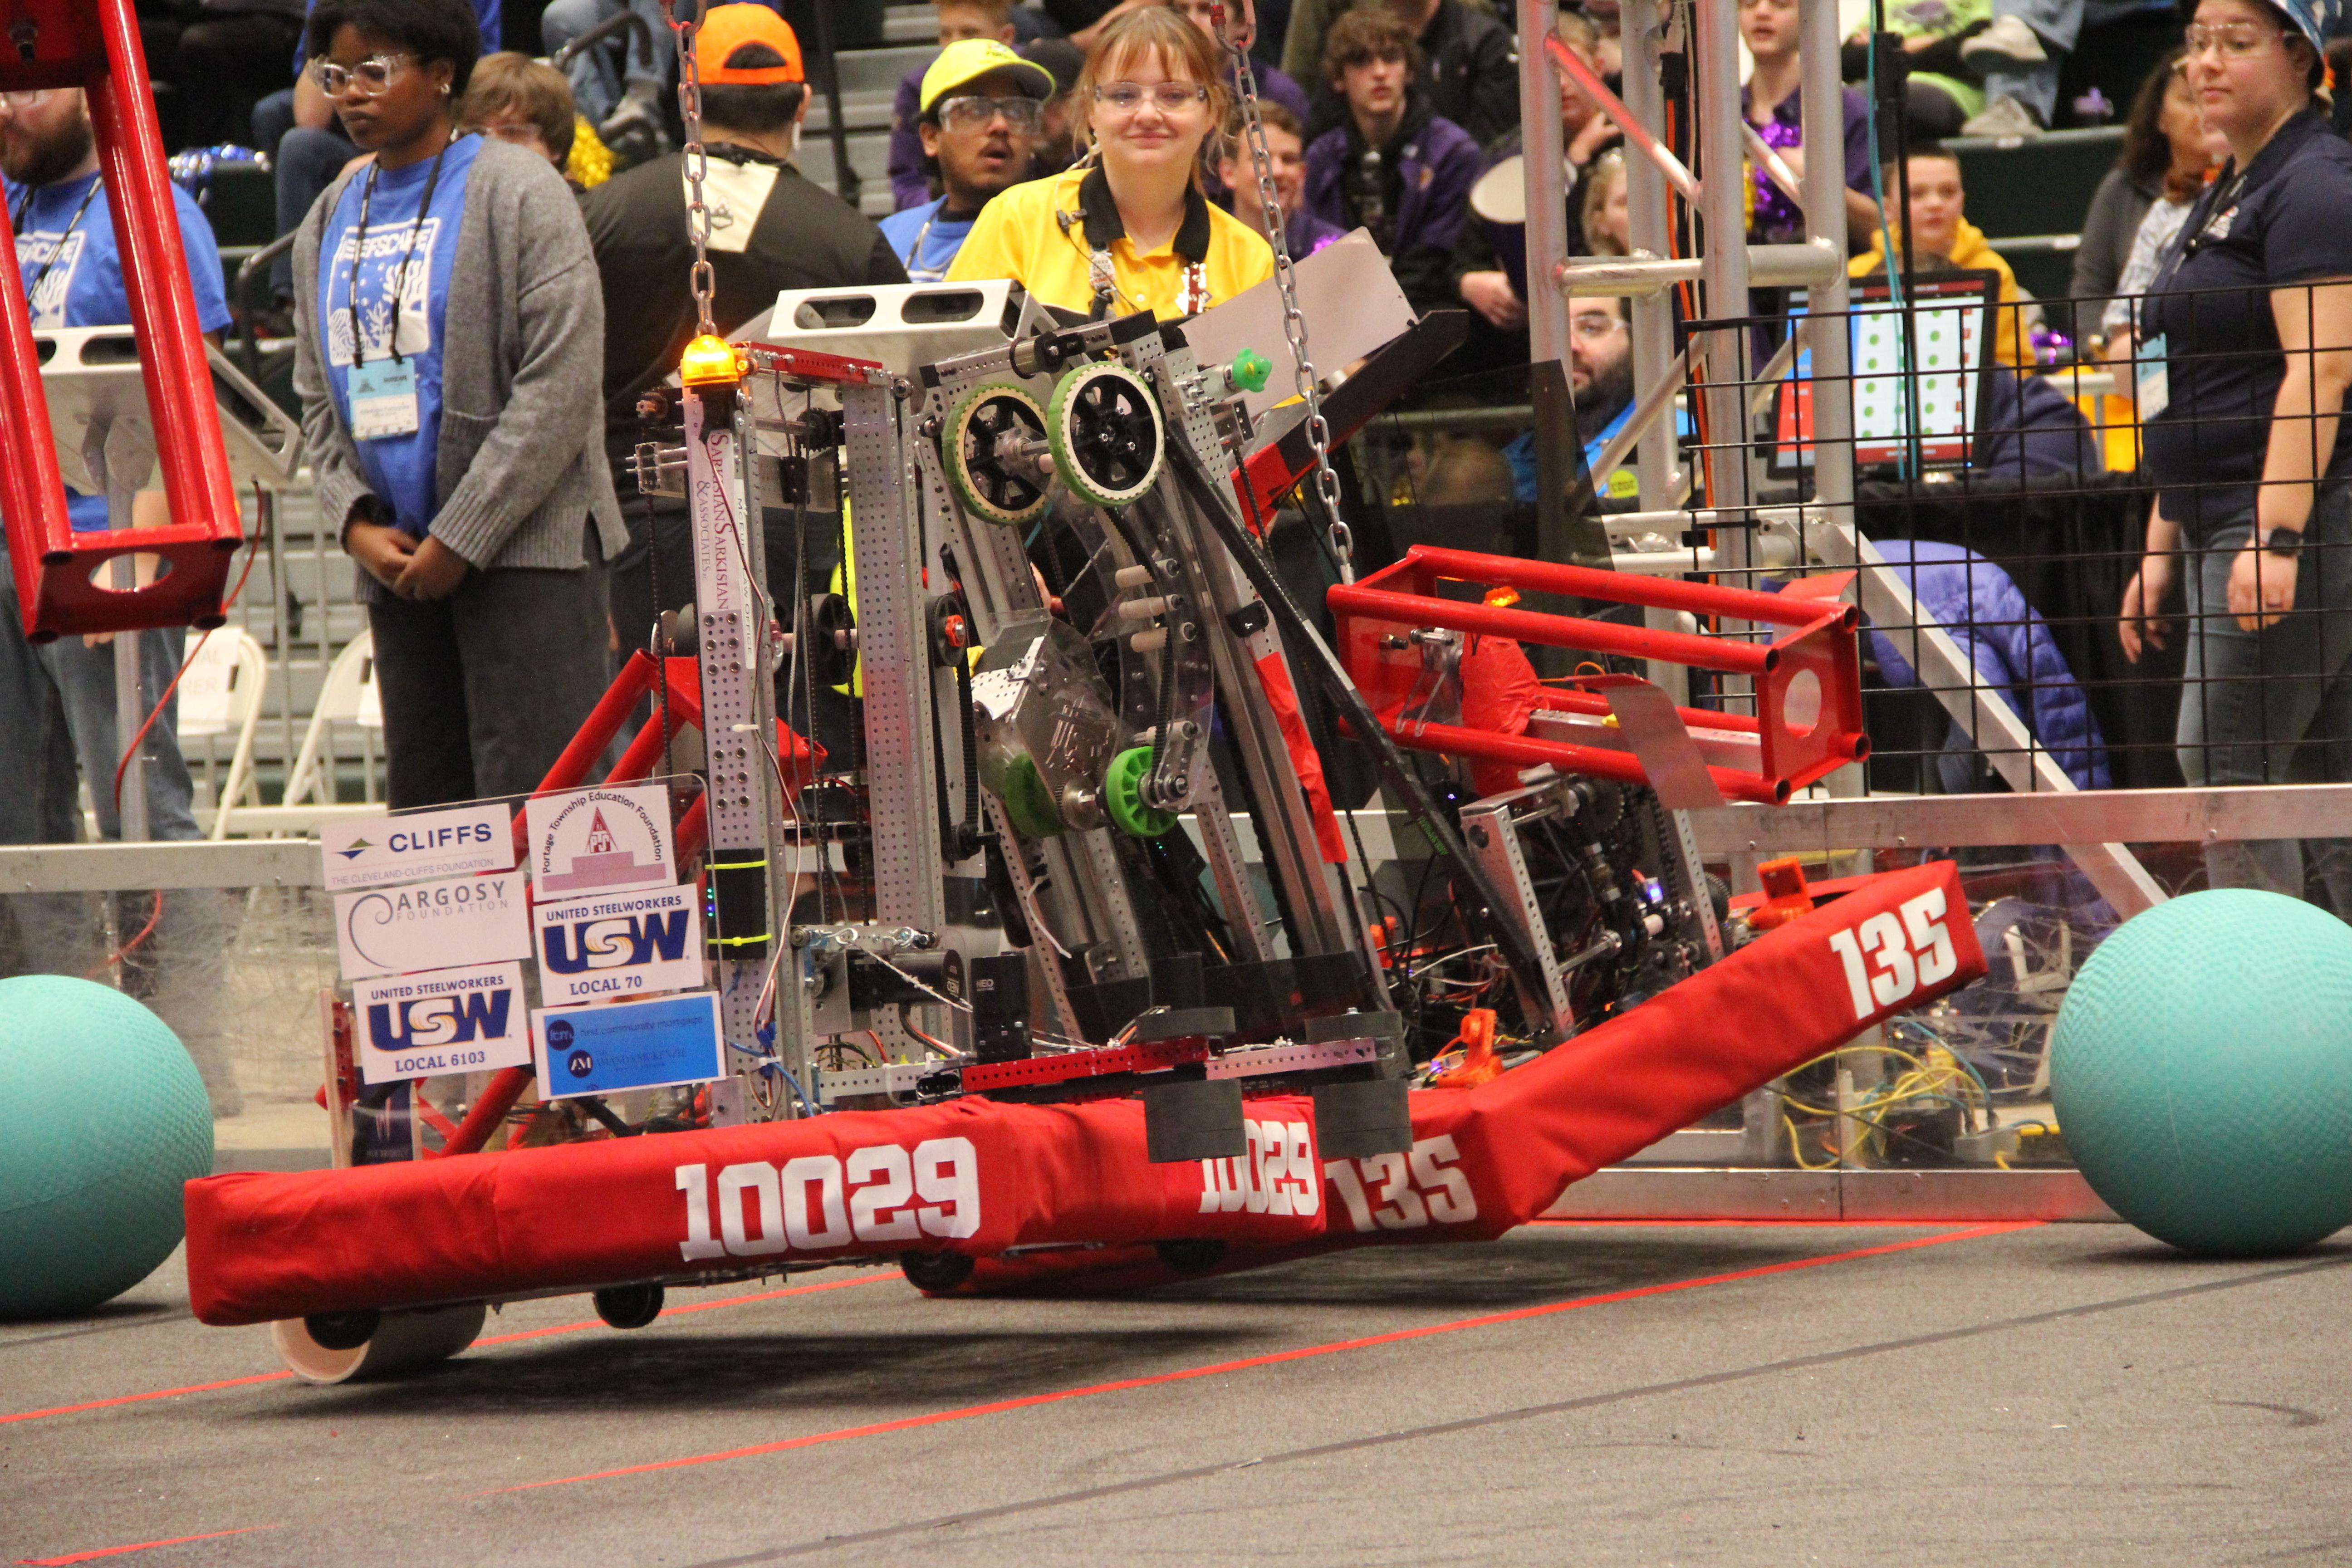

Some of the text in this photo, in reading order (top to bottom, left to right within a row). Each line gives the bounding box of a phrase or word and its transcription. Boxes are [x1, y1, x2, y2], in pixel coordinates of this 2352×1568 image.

[389, 823, 492, 852] CLIFFS
[543, 791, 662, 873] Portage Township Education Foundation
[332, 858, 494, 885] THE CLEVELAND-CLIFFS FOUNDATION
[397, 880, 505, 911] ARGOSY
[397, 899, 509, 921] FOUNDATION
[546, 896, 681, 921] UNITED STEELWORKERS
[542, 909, 690, 975] USW
[1829, 887, 1957, 1020] 135
[371, 975, 504, 1000] UNITED STEELWORKERS
[570, 975, 642, 995] LOCAL 70
[367, 988, 511, 1053] USW
[601, 1022, 656, 1035] community
[657, 1016, 703, 1029] mortgage
[395, 1051, 485, 1073] LOCAL 6103
[1198, 1118, 1319, 1216] 10029
[1324, 1133, 1477, 1232] 135
[675, 1137, 981, 1262] 10029
